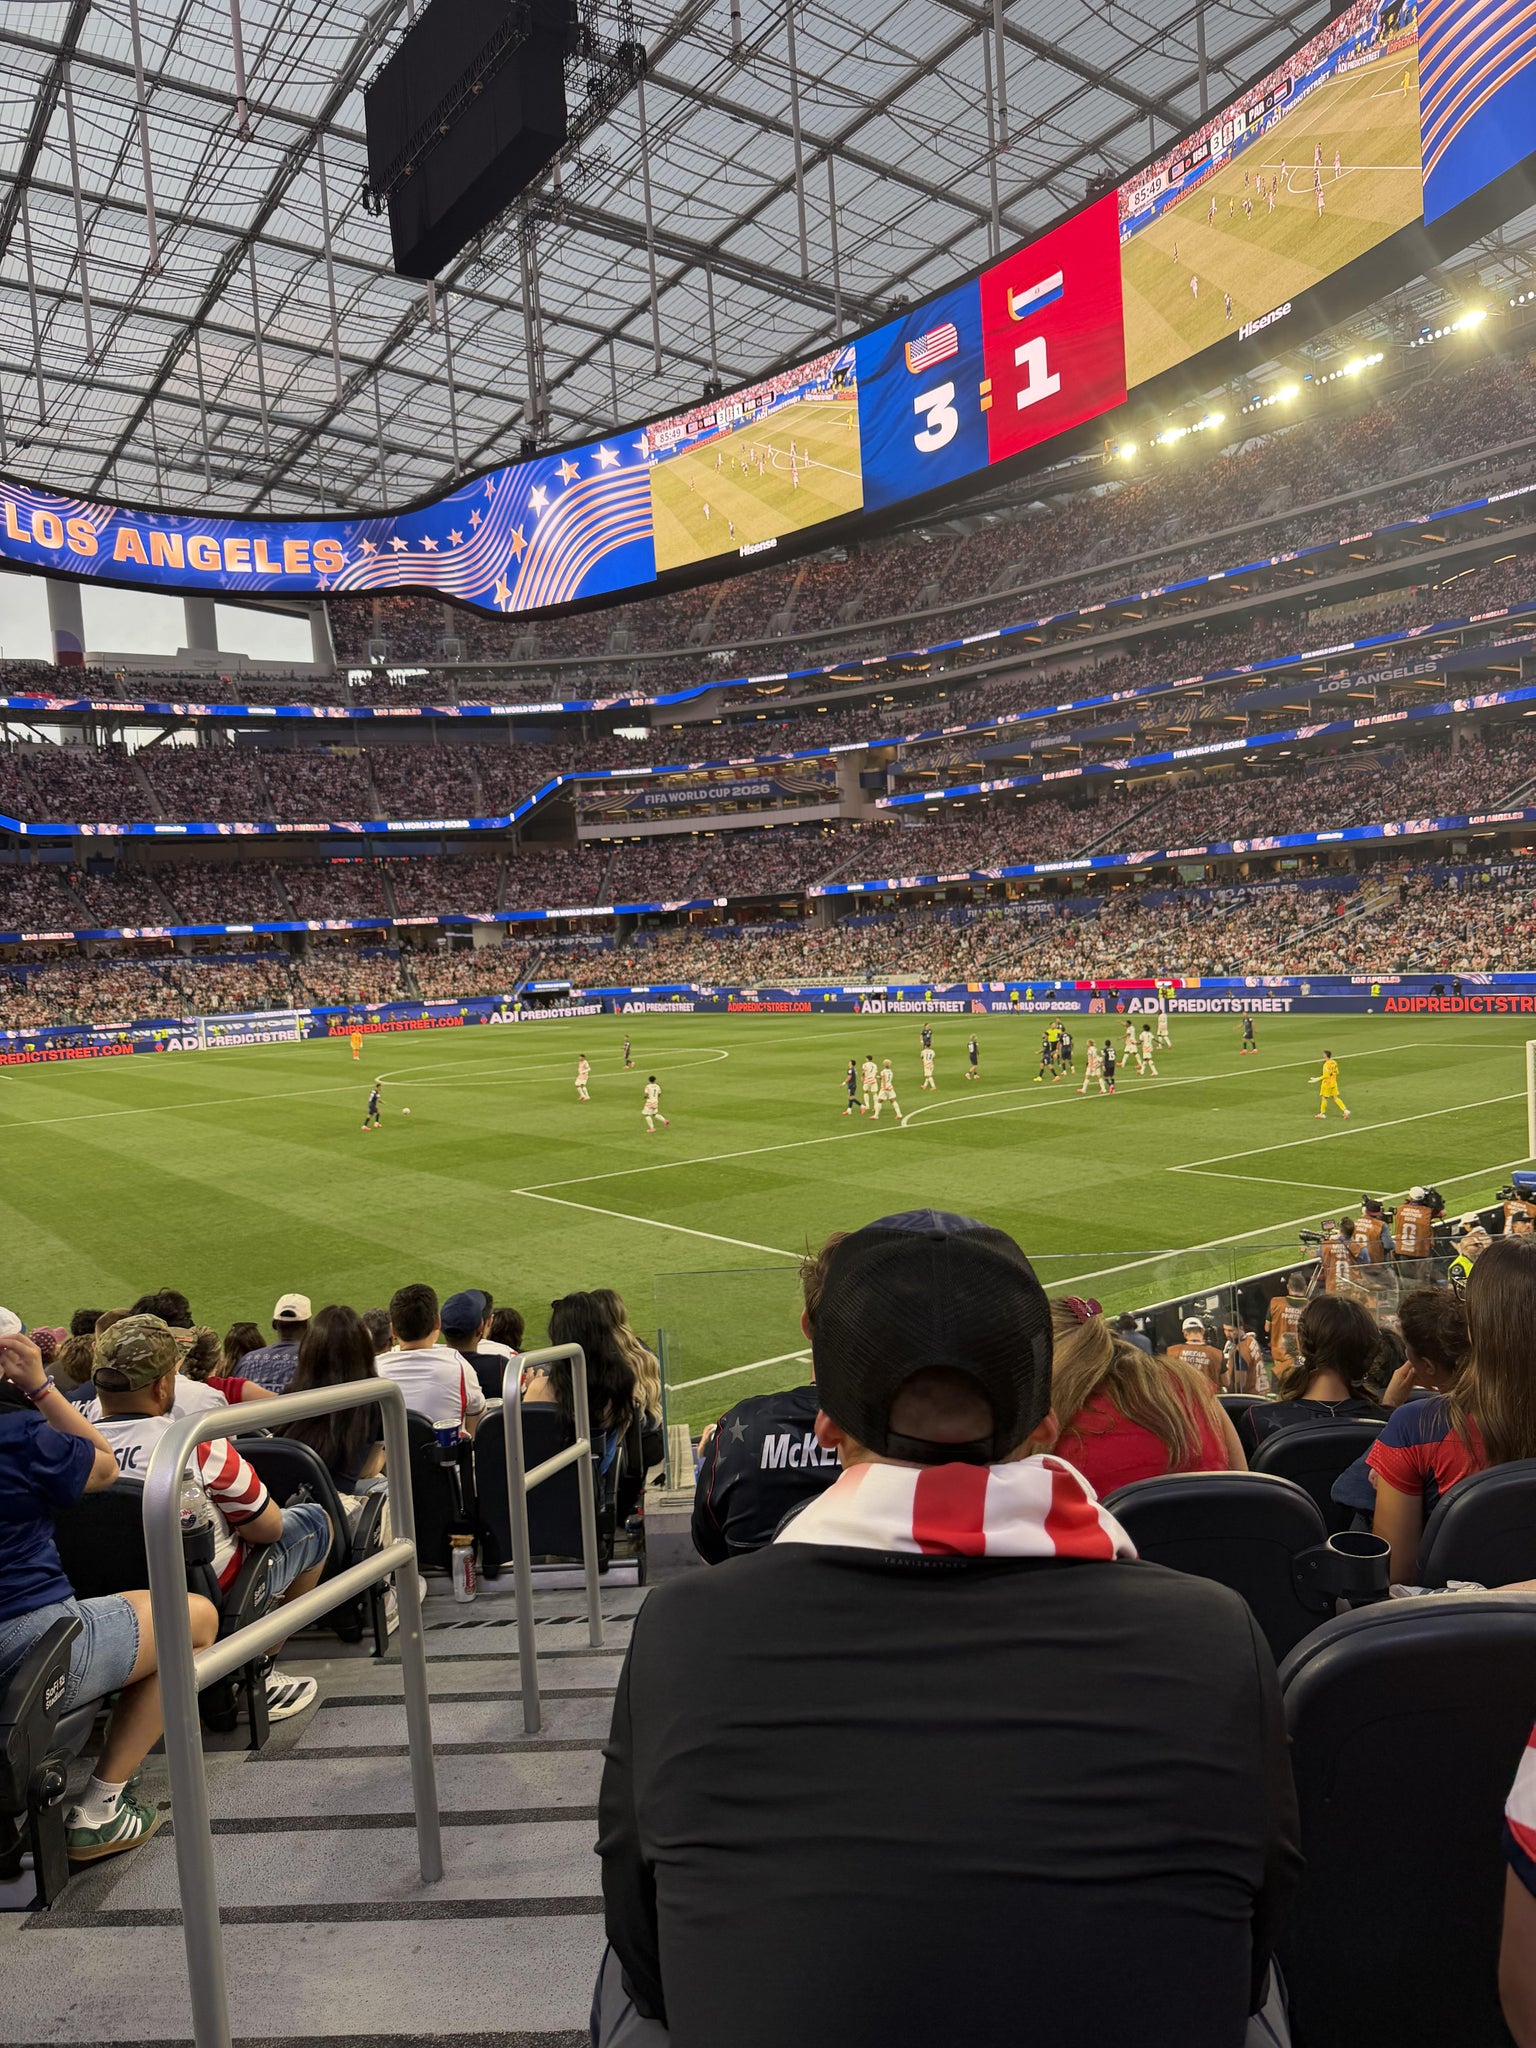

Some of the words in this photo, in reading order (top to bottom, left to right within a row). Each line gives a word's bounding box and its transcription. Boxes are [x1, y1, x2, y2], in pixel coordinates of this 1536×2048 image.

[1134, 178, 1162, 205] 85:49
[1193, 146, 1208, 164] USA
[1249, 102, 1265, 122] PAR
[1238, 302, 1292, 342] Hisense
[914, 381, 959, 453] 3
[1014, 336, 1061, 411] 1
[660, 428, 681, 443] 85:49
[5, 502, 99, 557] LOS
[113, 527, 345, 574] ANGELES
[740, 538, 777, 557] Hisense
[1318, 679, 1351, 693] LOS
[1355, 661, 1437, 687] ANGELES
[1354, 718, 1370, 728] LOS
[1371, 711, 1408, 724] ANGELES
[1173, 749, 1188, 759] FIFA
[1187, 746, 1210, 758] WORLD
[1210, 743, 1223, 753] CUP
[645, 794, 668, 805] FIFA
[668, 791, 707, 803] WORLD
[709, 788, 730, 799] CUP
[732, 784, 770, 796] 2026
[1469, 815, 1486, 824] LOS
[1486, 811, 1524, 823] ANGELES
[489, 1010, 520, 1024] ADI
[521, 1004, 602, 1021] PREDICTSTREET
[623, 1002, 646, 1013] ADI
[646, 1002, 695, 1012] PREDICTSTREET
[727, 1002, 812, 1013] ADIPREDICTSTREET.COM
[861, 1000, 886, 1014] ADI
[887, 1001, 965, 1012] PREDICTSTREET
[992, 1002, 1006, 1011] FIFA
[1006, 1002, 1035, 1011] WRLD
[1035, 1002, 1051, 1011] CUP
[1127, 997, 1165, 1014] ADI
[1168, 998, 1292, 1013] PREDICTSTREET
[328, 1017, 464, 1037] ADIPREDICTSTREET.COM
[166, 1036, 204, 1051] ADI
[207, 1029, 310, 1047] PREDICTSTREET
[1182, 1350, 1207, 1358] MEDIA
[760, 1432, 841, 1469] McKE
